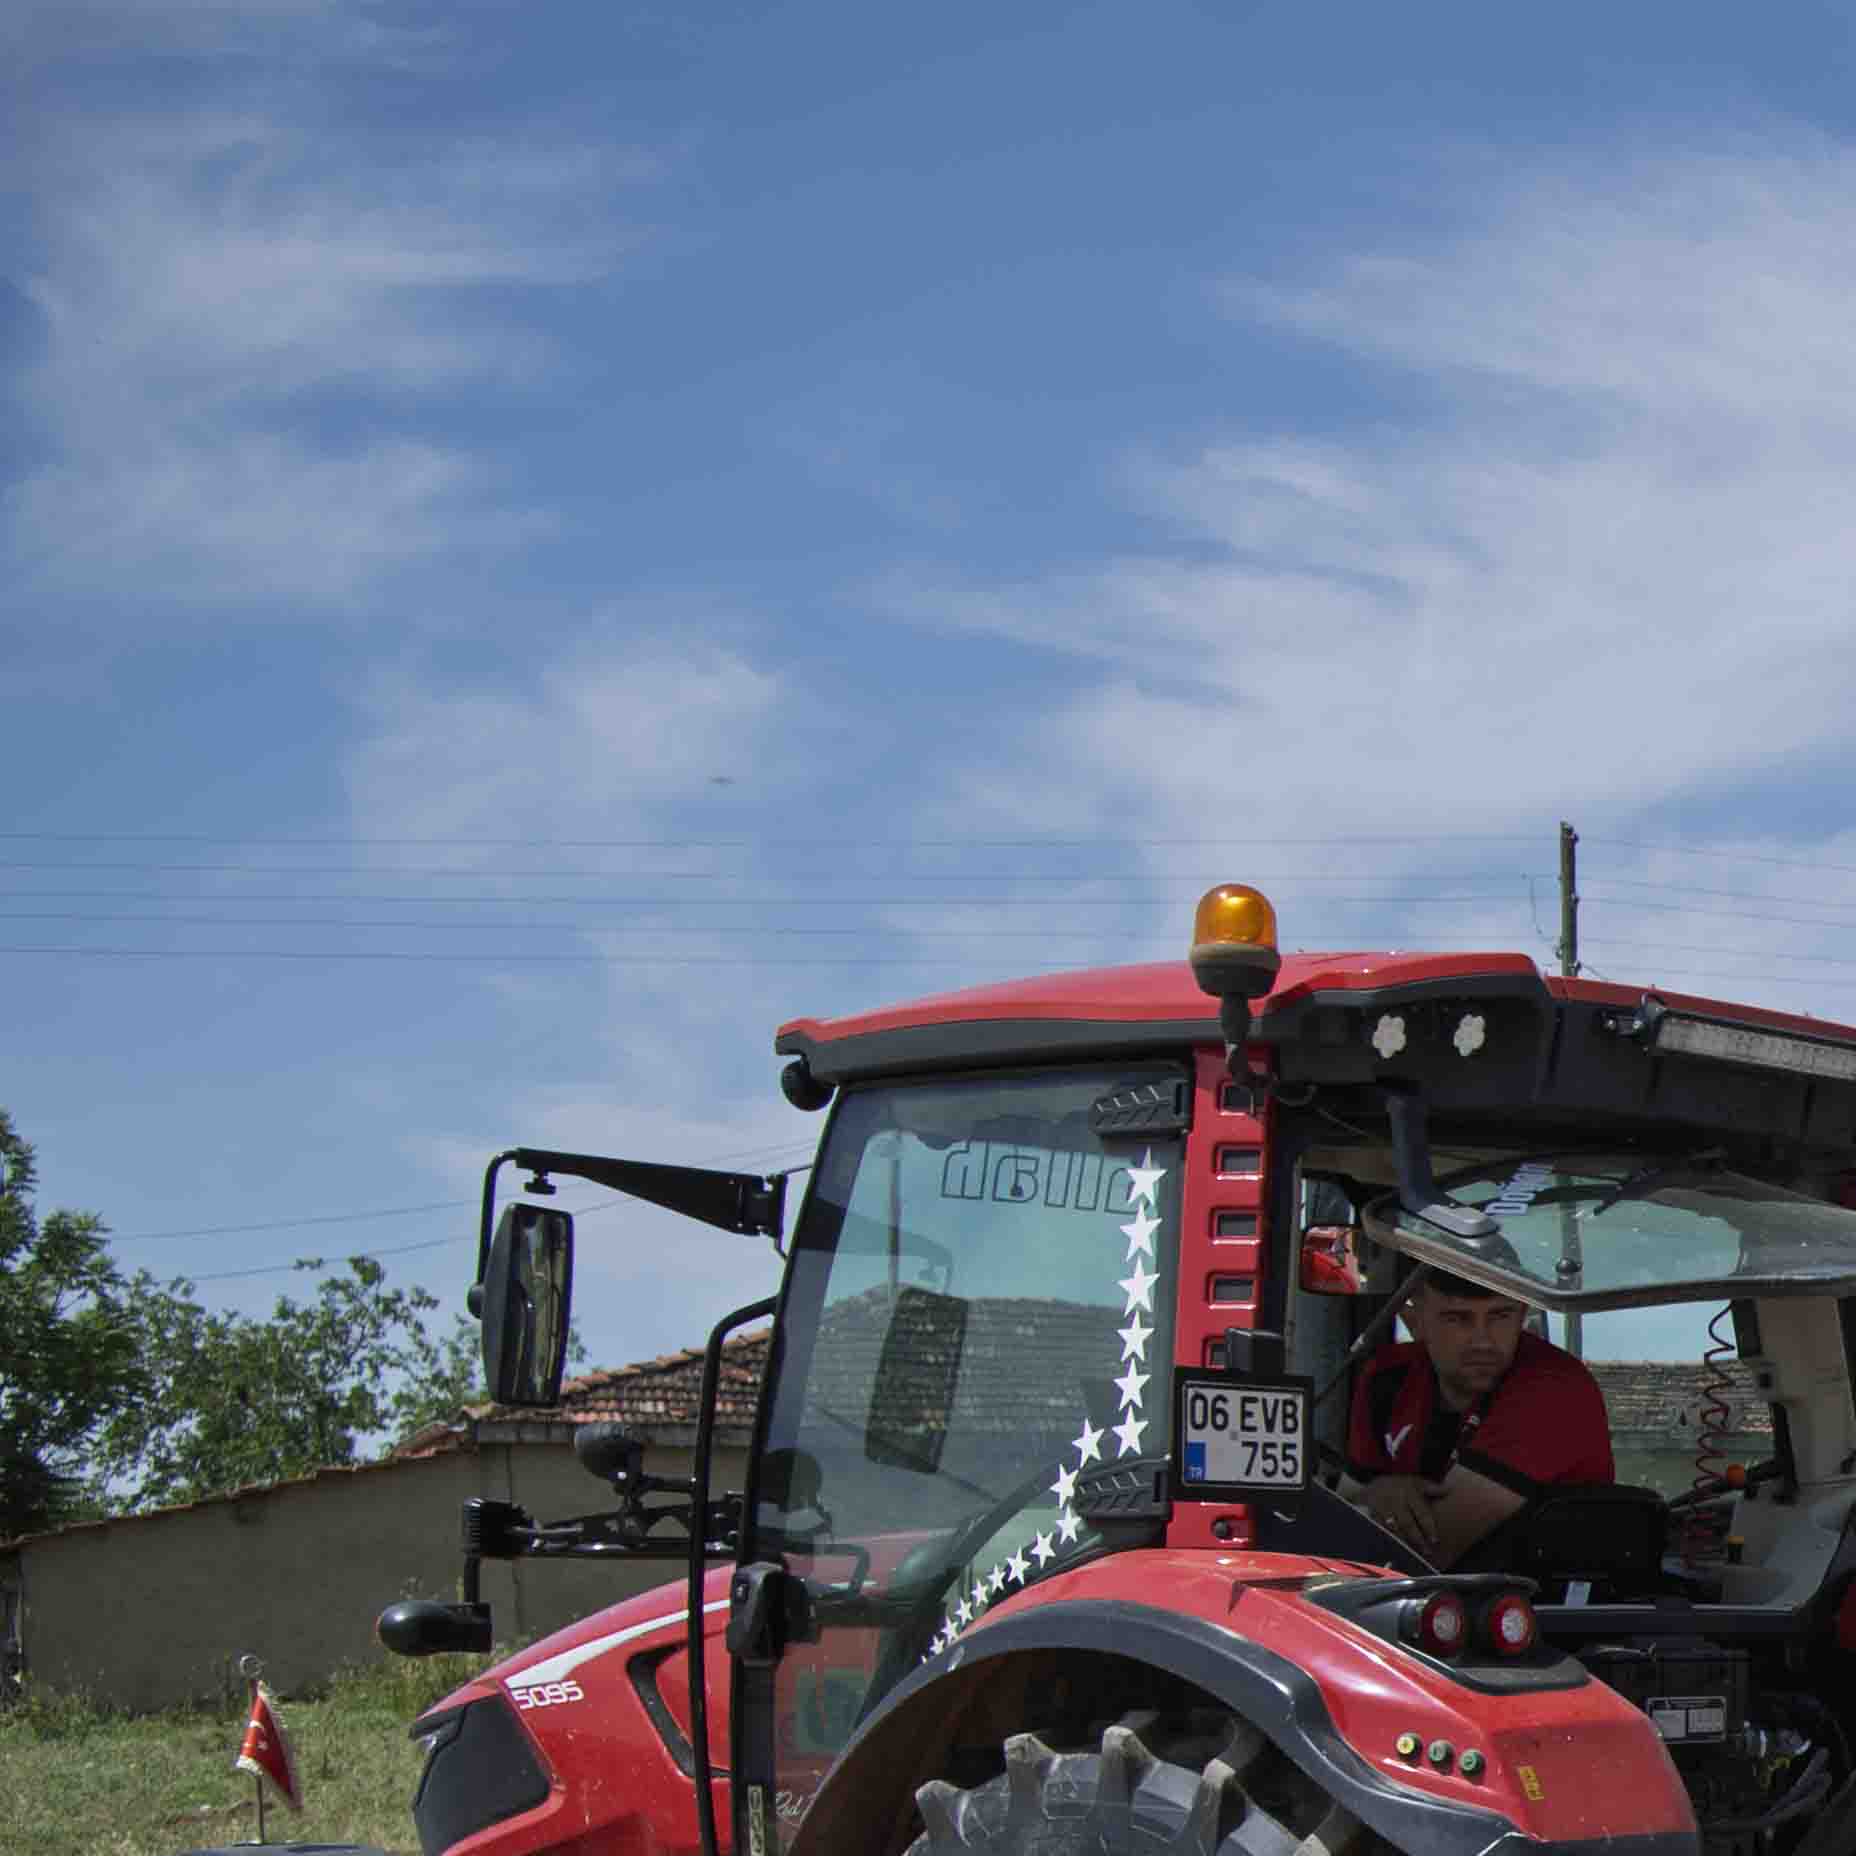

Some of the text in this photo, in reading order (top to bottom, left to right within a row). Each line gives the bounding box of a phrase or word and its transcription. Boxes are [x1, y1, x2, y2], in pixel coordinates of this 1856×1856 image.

[1189, 1390, 1300, 1435] 06 EVB
[1240, 1441, 1300, 1479] 755
[511, 1679, 585, 1710] 5095
